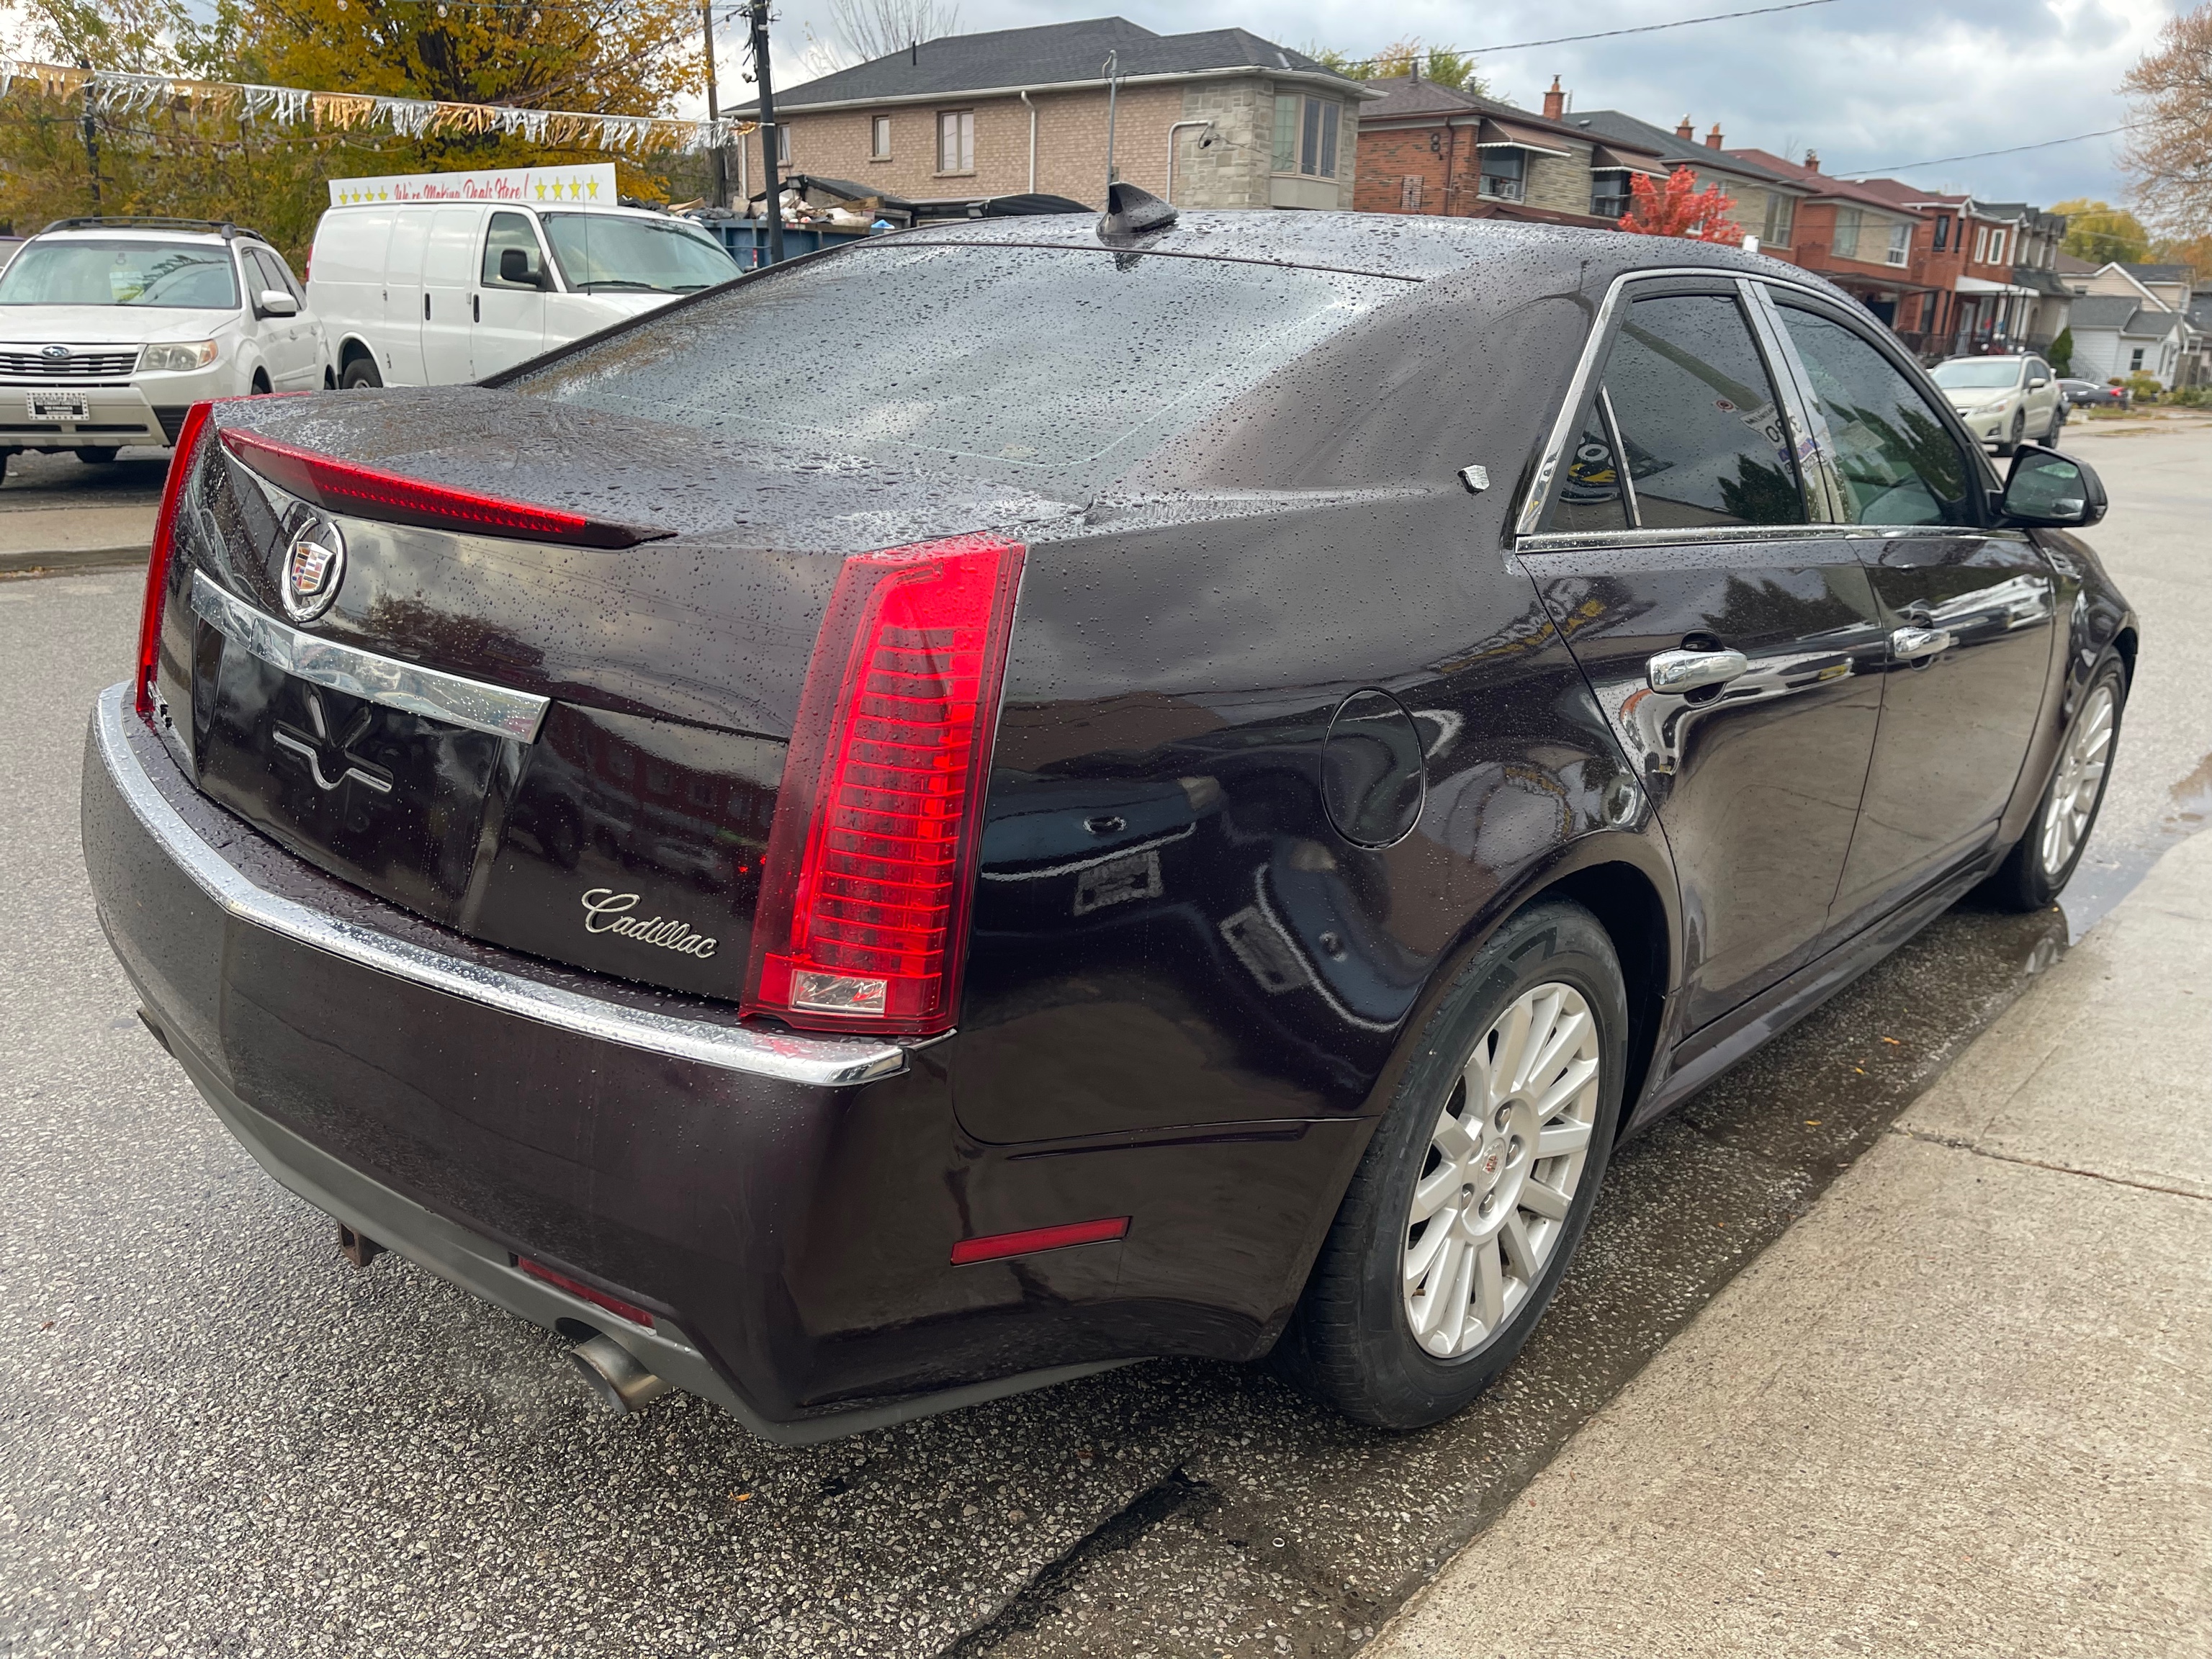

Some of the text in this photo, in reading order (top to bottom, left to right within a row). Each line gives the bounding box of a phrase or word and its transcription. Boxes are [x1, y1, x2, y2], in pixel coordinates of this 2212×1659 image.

[395, 181, 420, 199] We're
[463, 179, 493, 199] Deals
[495, 173, 529, 199] Here!
[581, 889, 717, 958] Cadillac
